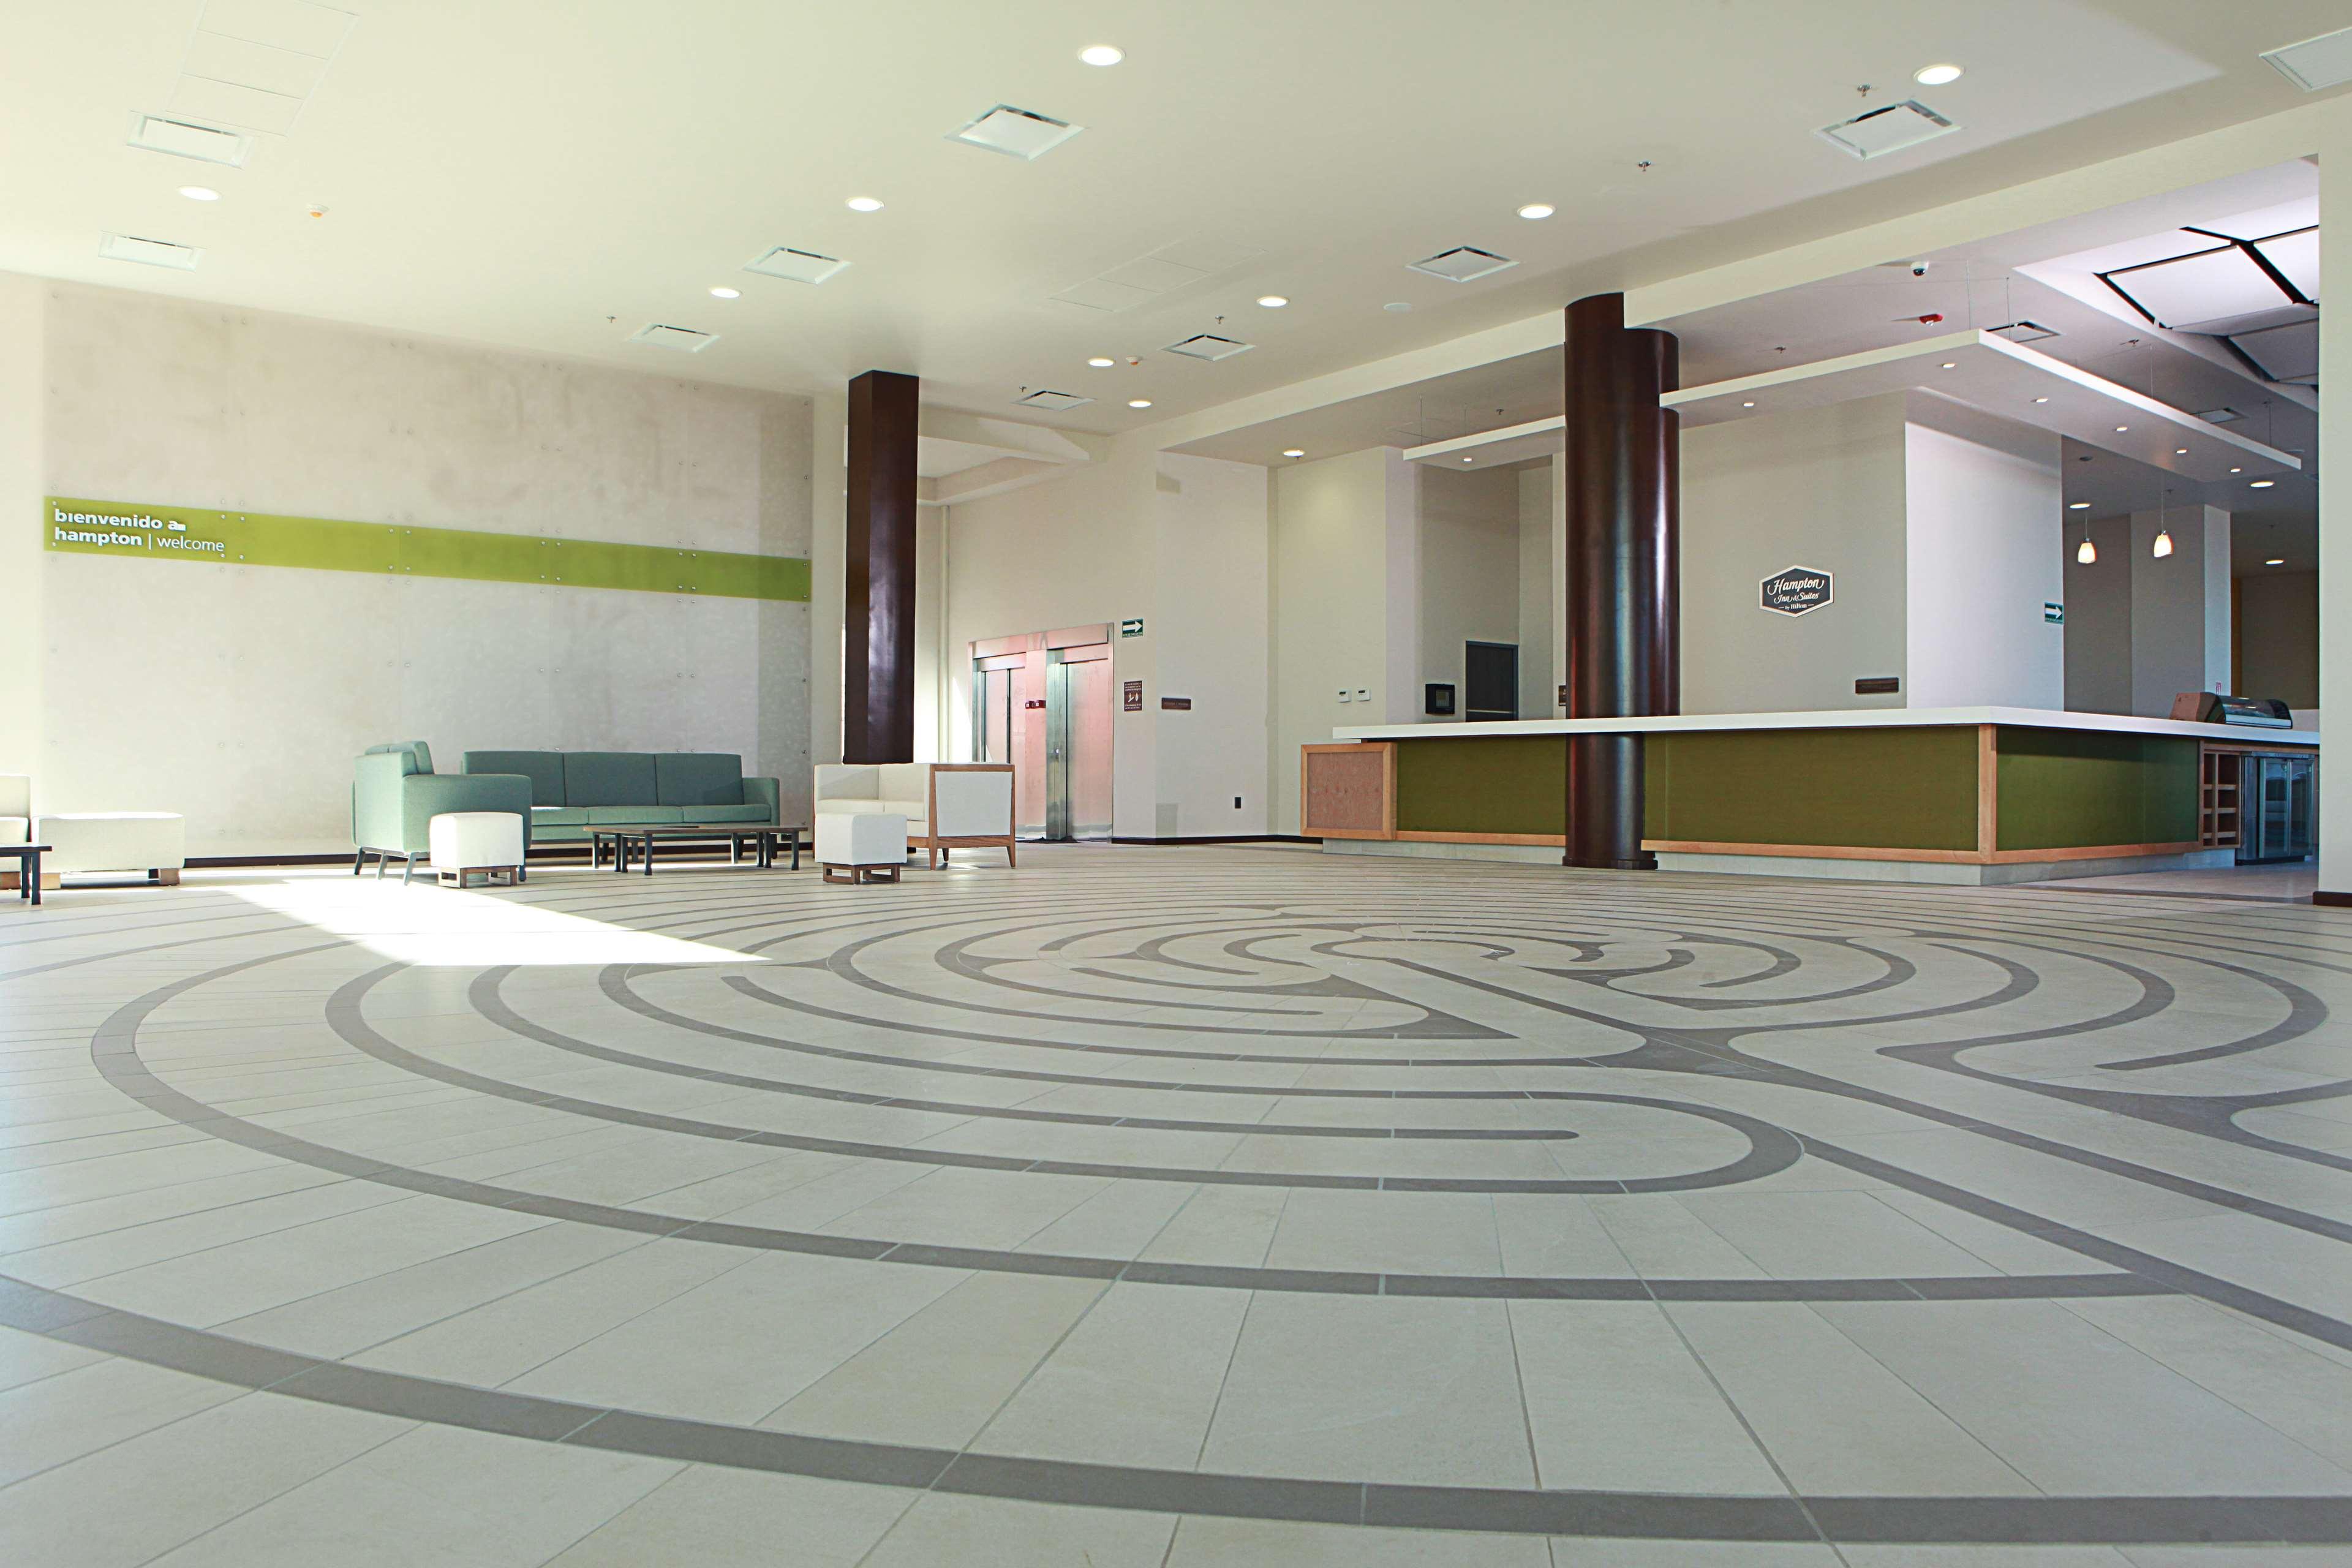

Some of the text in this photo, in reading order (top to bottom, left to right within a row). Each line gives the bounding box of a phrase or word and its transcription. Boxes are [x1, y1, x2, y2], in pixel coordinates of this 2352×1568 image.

[55, 508, 163, 529] bienvenido
[55, 527, 225, 551] hampton welcome
[1767, 577, 1825, 595] Hampton
[1774, 594, 1792, 604] Inn
